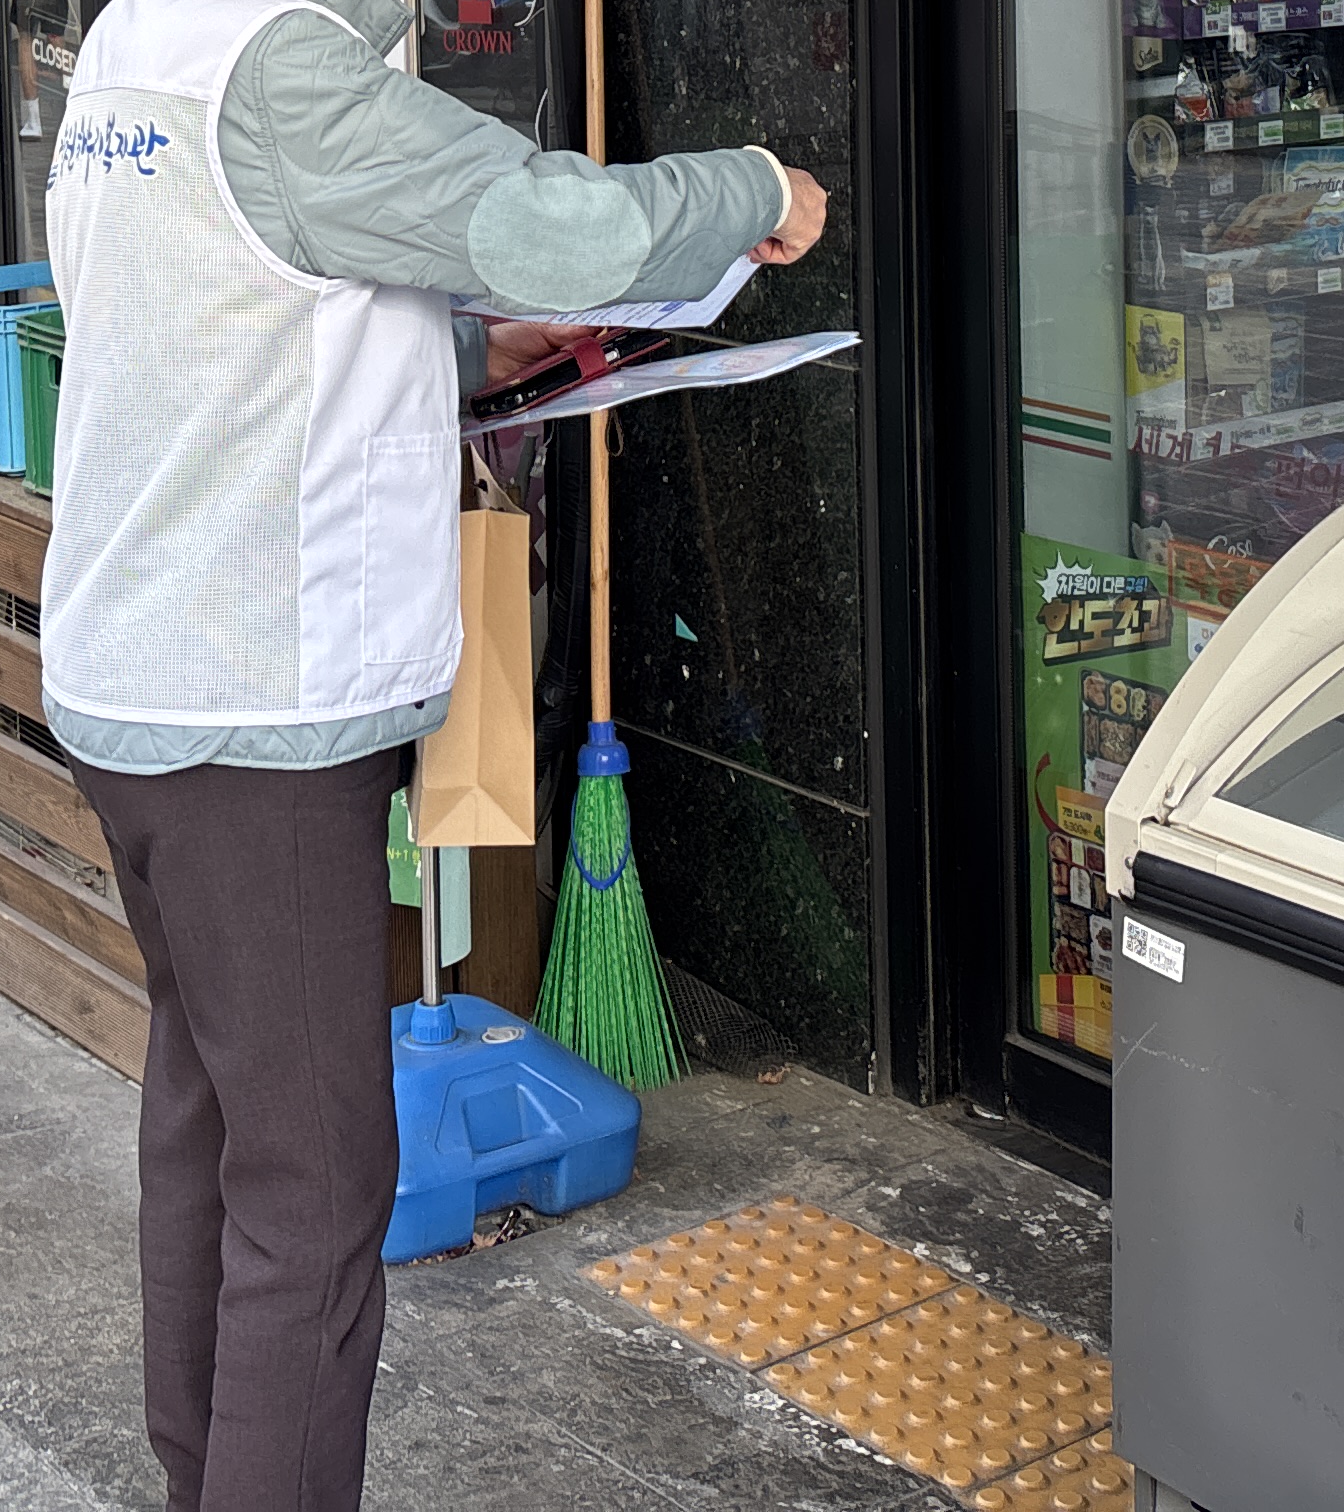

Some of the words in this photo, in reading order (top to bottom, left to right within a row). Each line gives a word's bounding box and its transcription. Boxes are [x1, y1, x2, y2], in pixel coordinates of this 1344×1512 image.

[32, 38, 77, 74] CLOSED
[443, 29, 513, 55] CROWN
[1057, 573, 1101, 595] 차원이
[1102, 575, 1126, 594] 다른
[1125, 576, 1148, 594] 구성!
[1038, 597, 1173, 661] 한도초과
